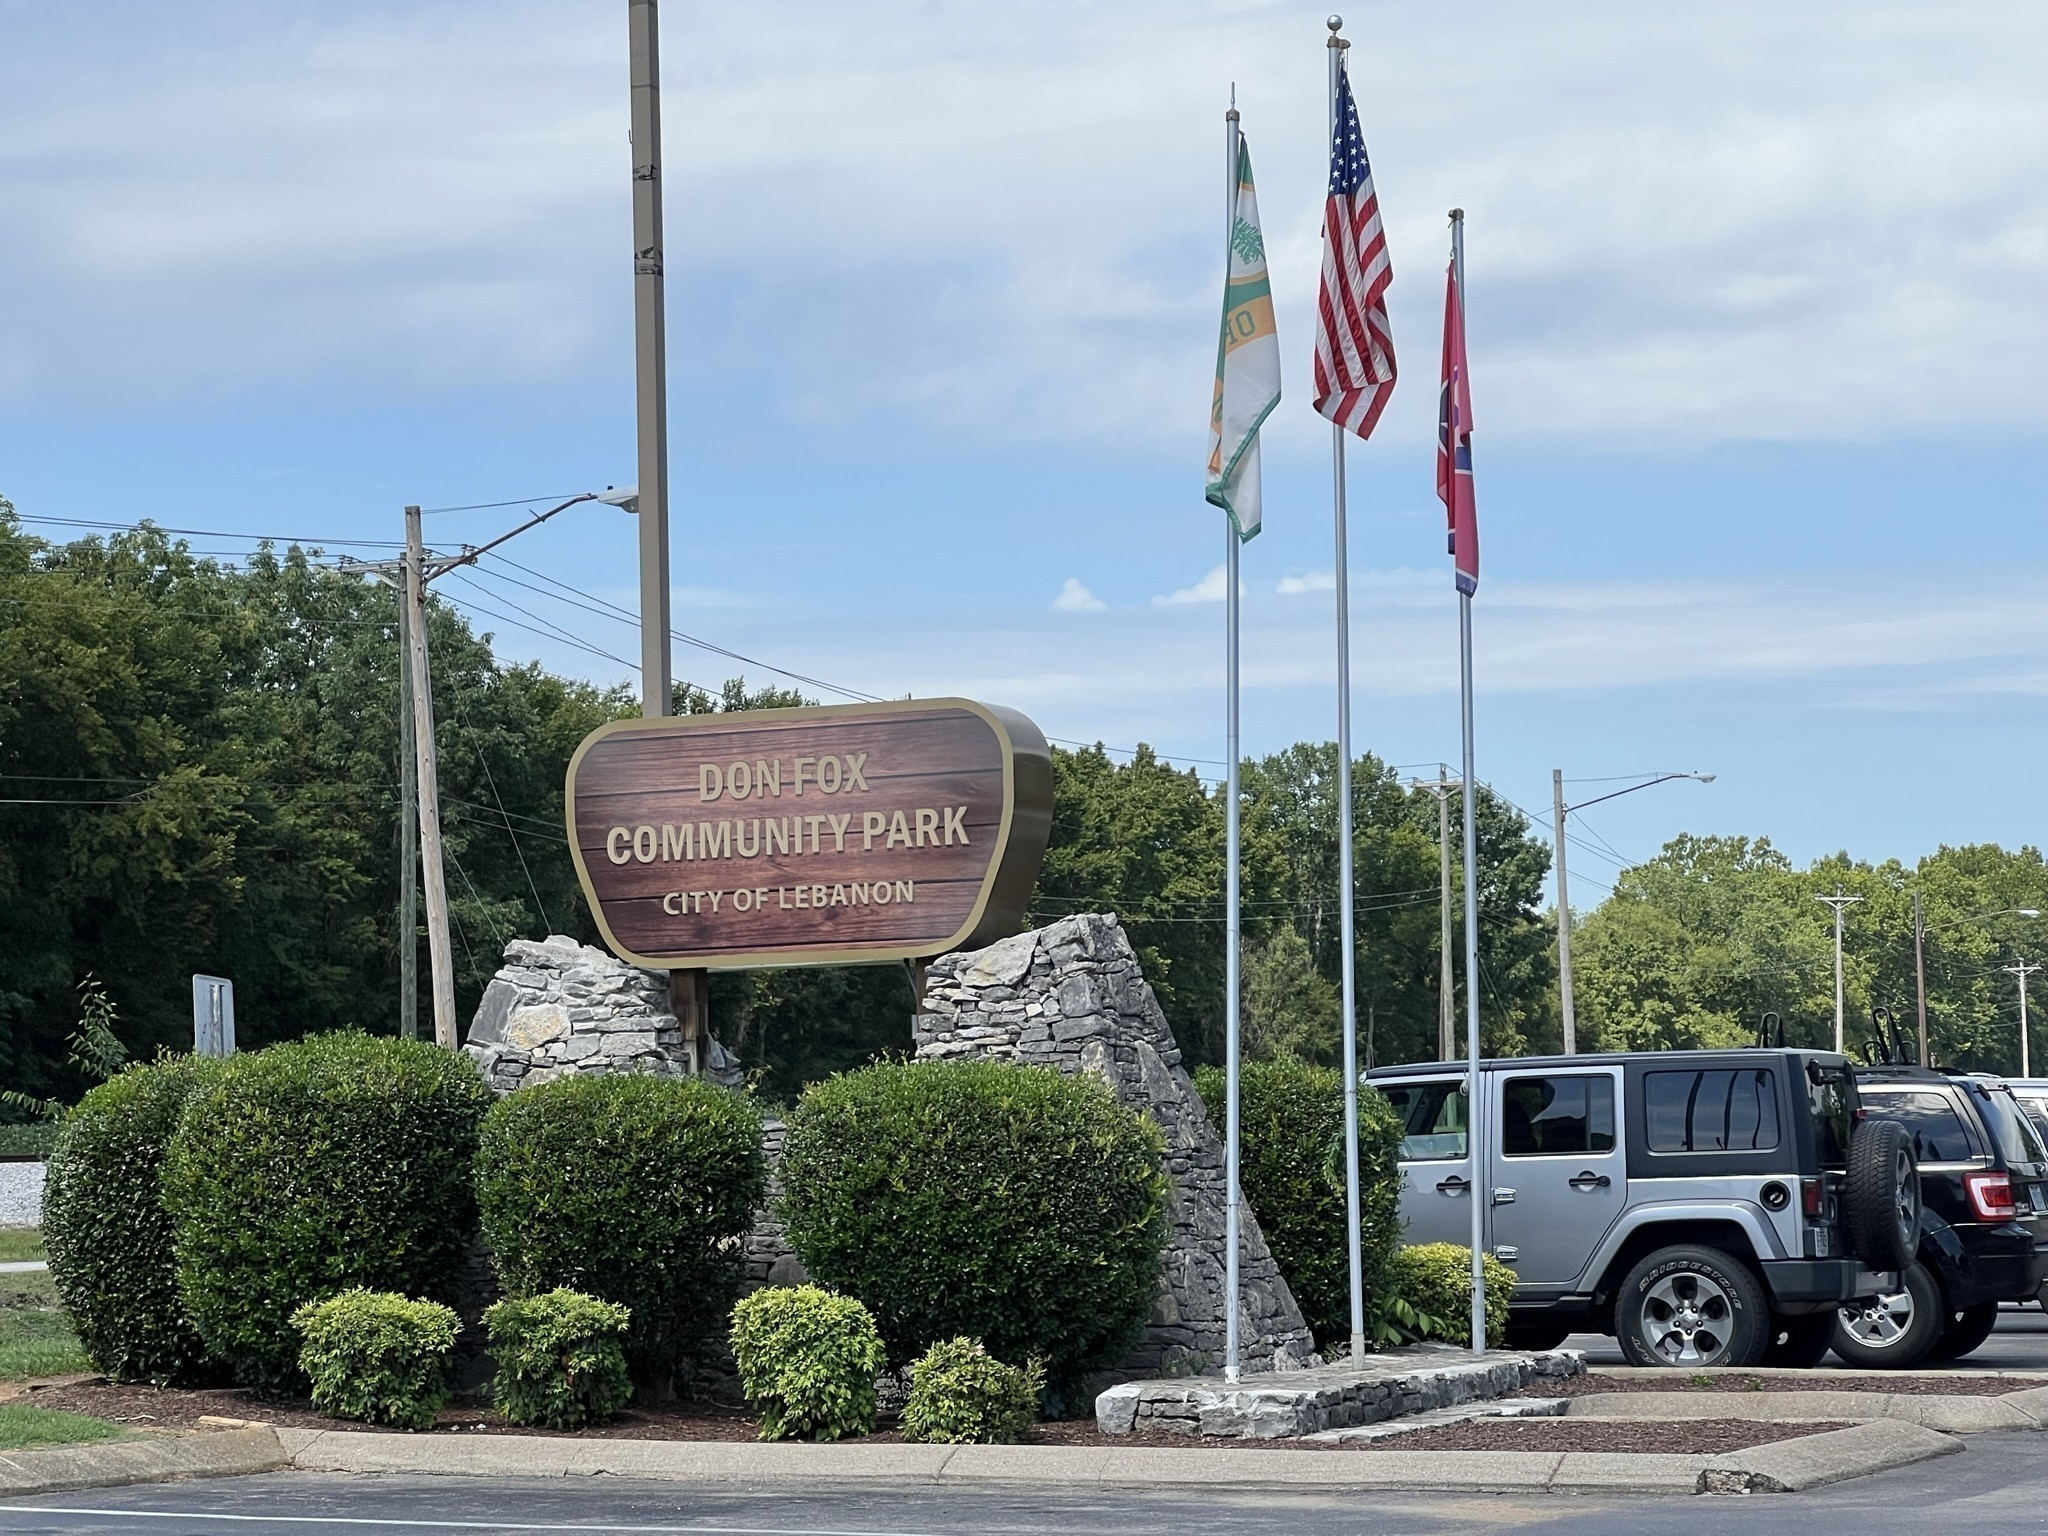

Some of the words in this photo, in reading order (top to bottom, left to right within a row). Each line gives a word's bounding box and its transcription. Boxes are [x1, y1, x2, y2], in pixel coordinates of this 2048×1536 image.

[699, 758, 781, 802] DON
[794, 753, 870, 796] FOX
[605, 813, 851, 865] COMMUNITY
[863, 806, 970, 851] PARK
[662, 890, 724, 916] CITY
[732, 887, 769, 912] OF
[779, 880, 914, 910] LEBANON
[1639, 1261, 1743, 1310] BRIDGESTONE
